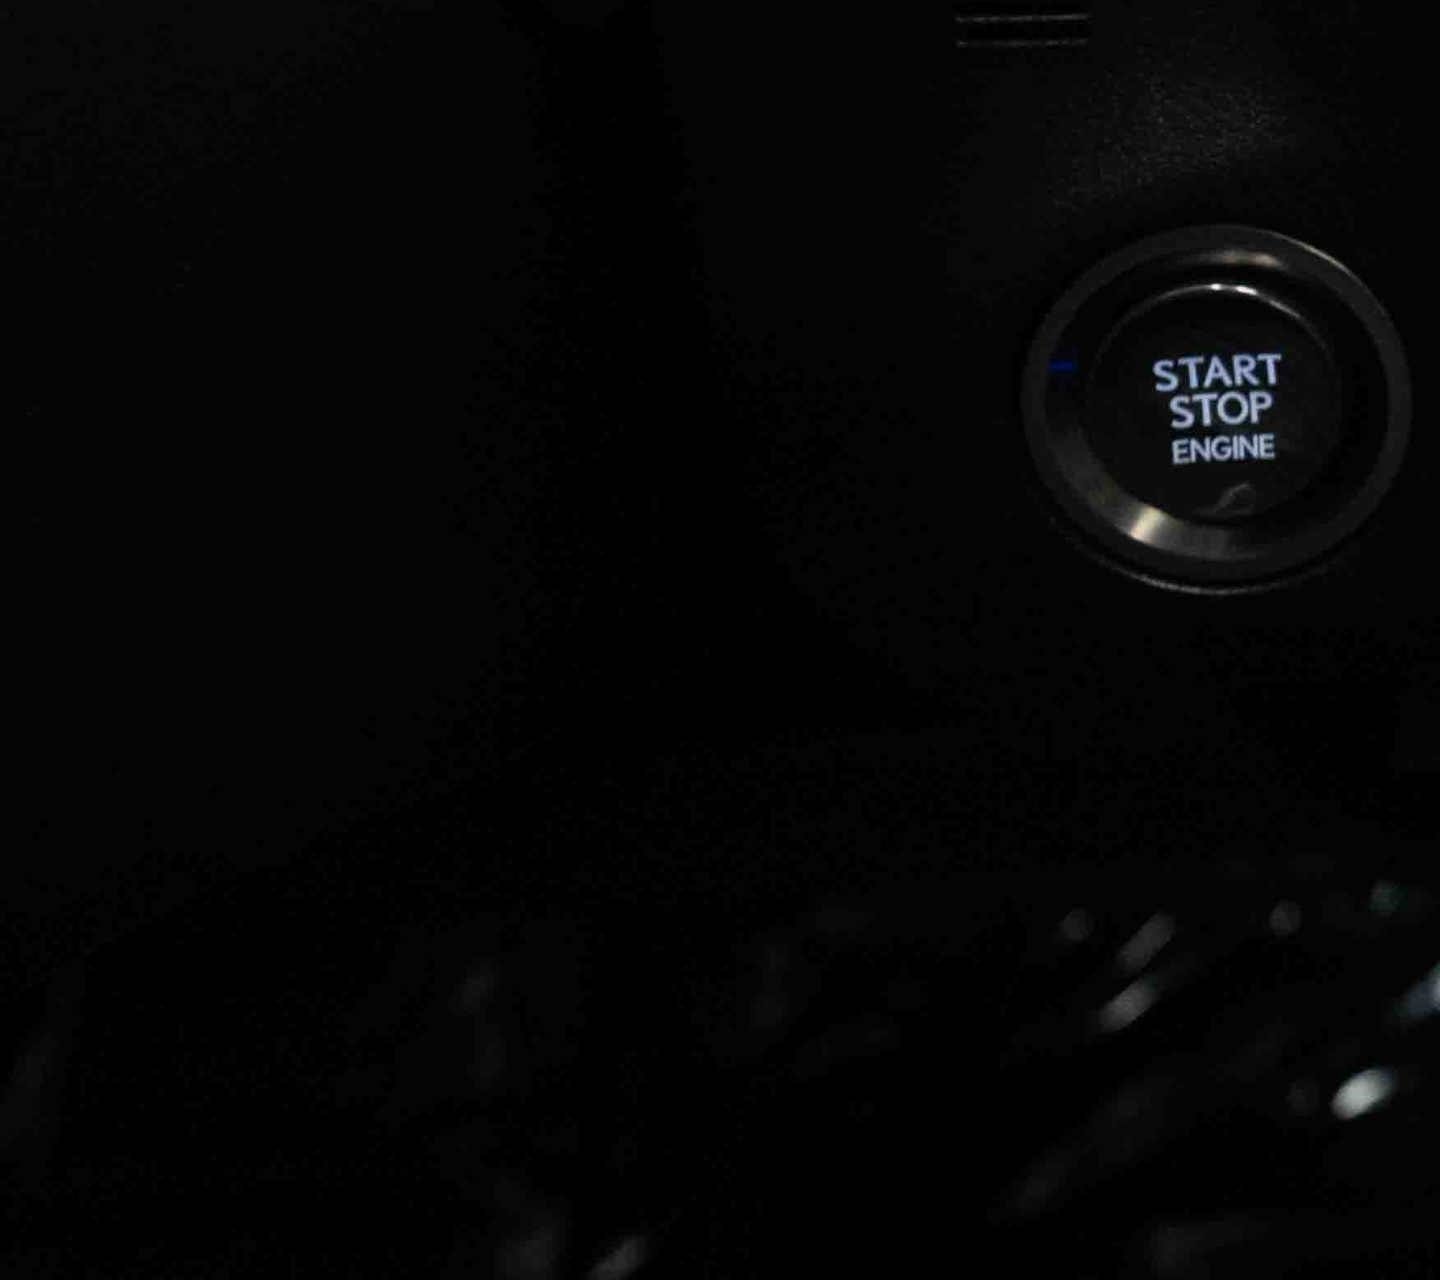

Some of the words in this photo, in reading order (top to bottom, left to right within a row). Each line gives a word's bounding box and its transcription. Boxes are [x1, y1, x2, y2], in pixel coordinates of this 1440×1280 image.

[1152, 353, 1282, 393] START
[1168, 390, 1273, 430] STOP
[1171, 433, 1275, 465] ENGINE
